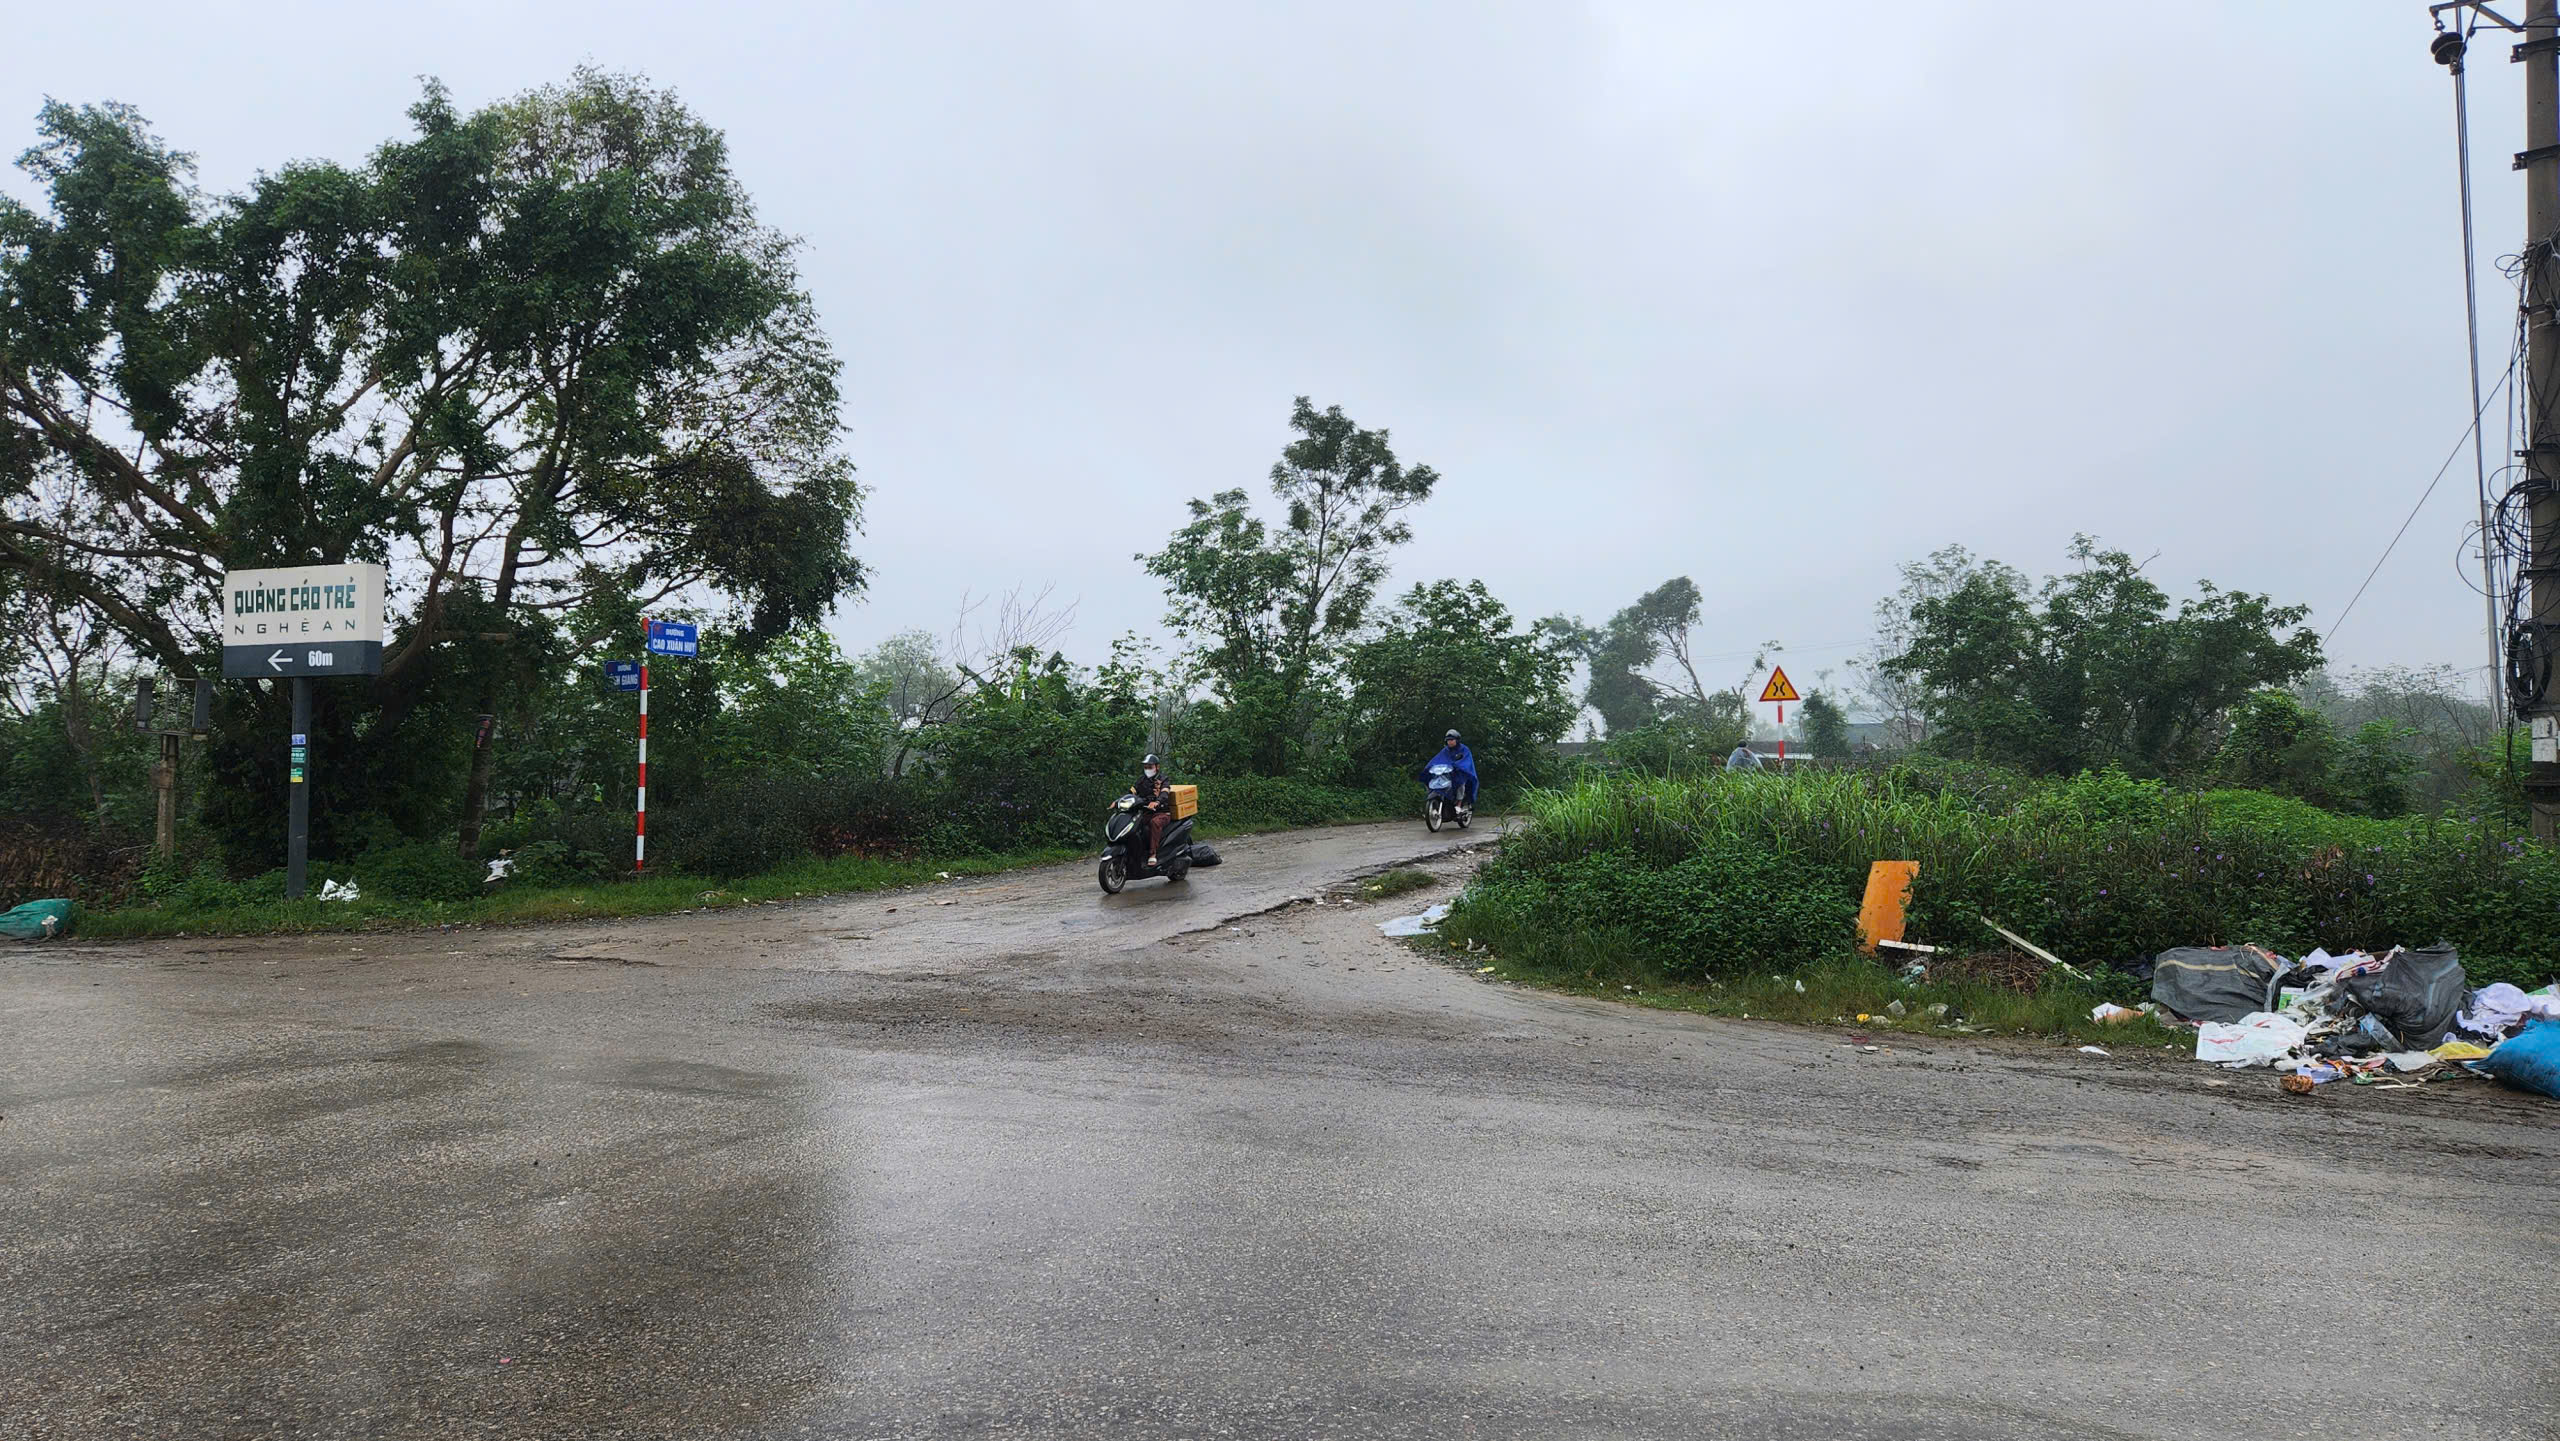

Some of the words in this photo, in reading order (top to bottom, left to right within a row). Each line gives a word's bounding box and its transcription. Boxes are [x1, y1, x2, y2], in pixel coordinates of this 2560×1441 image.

[234, 580, 286, 617] QUẢNG
[290, 578, 320, 611] CÁO
[653, 638, 665, 650] CAO
[667, 638, 683, 652] XUÂN
[684, 642, 696, 652] HUY
[308, 650, 333, 667] 60m
